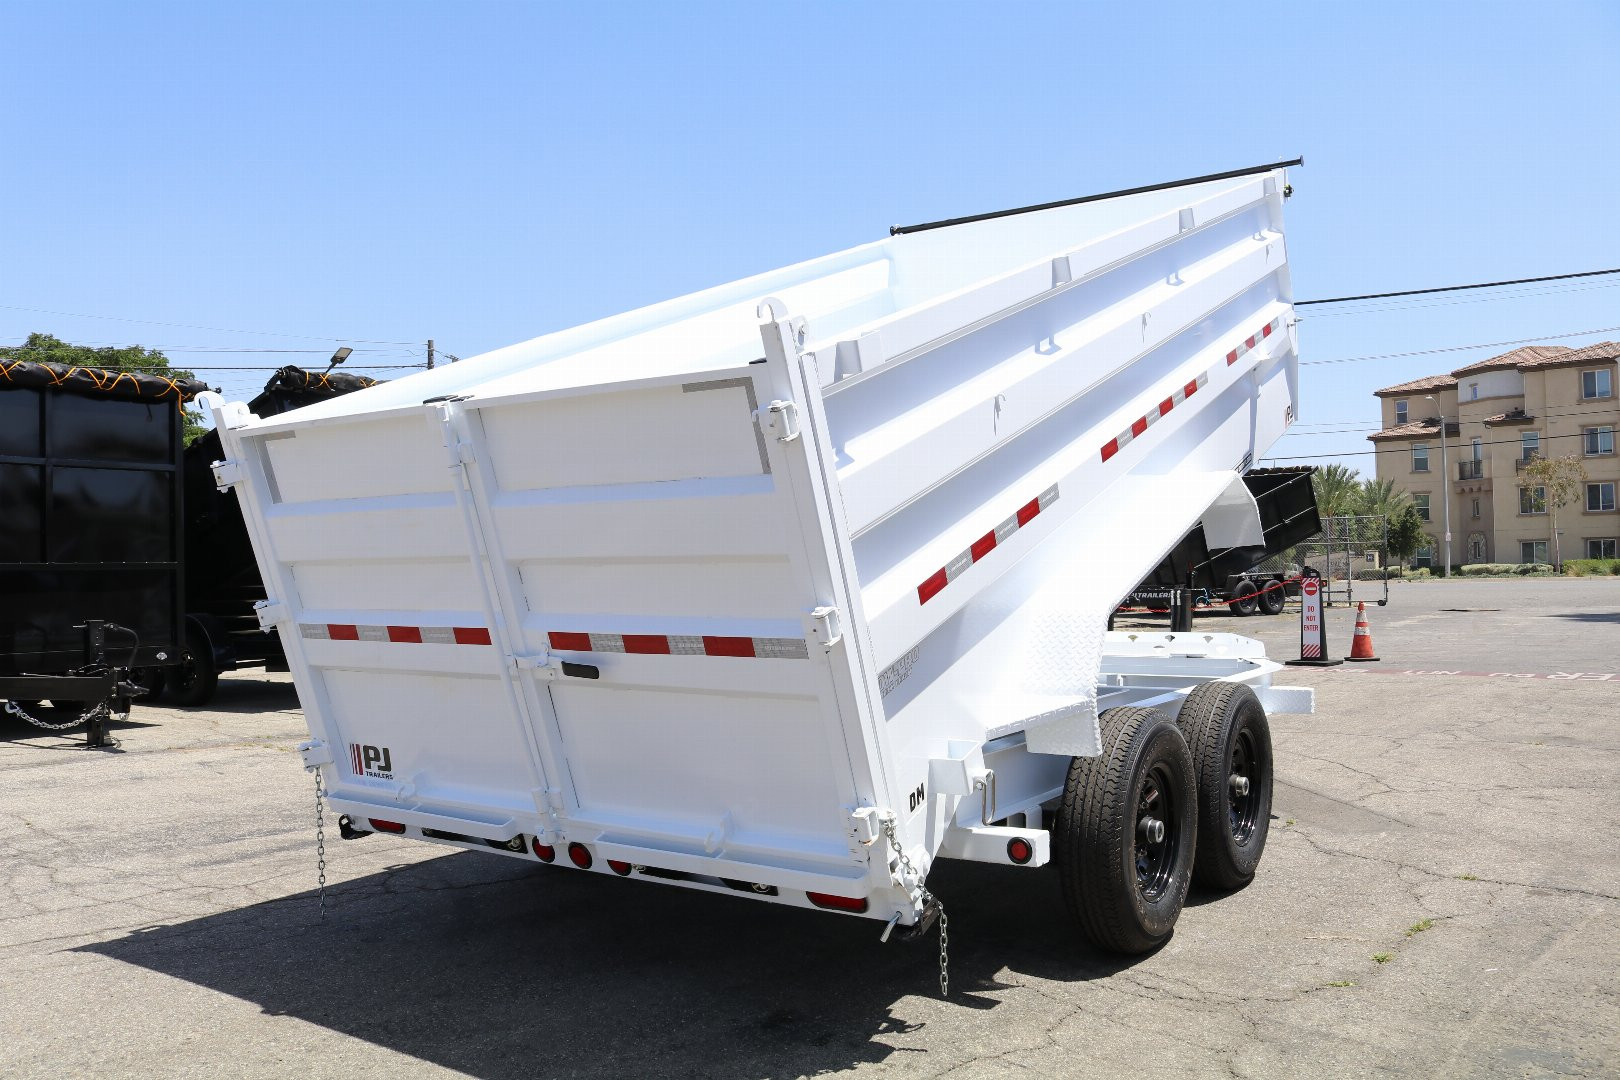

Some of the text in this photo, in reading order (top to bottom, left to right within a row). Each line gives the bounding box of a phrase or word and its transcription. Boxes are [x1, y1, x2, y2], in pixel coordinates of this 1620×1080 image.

[1307, 605, 1315, 613] DO
[1303, 624, 1319, 632] ENTER
[363, 745, 392, 772] PJ
[365, 770, 394, 780] TRAILERS
[909, 782, 925, 813] DM
